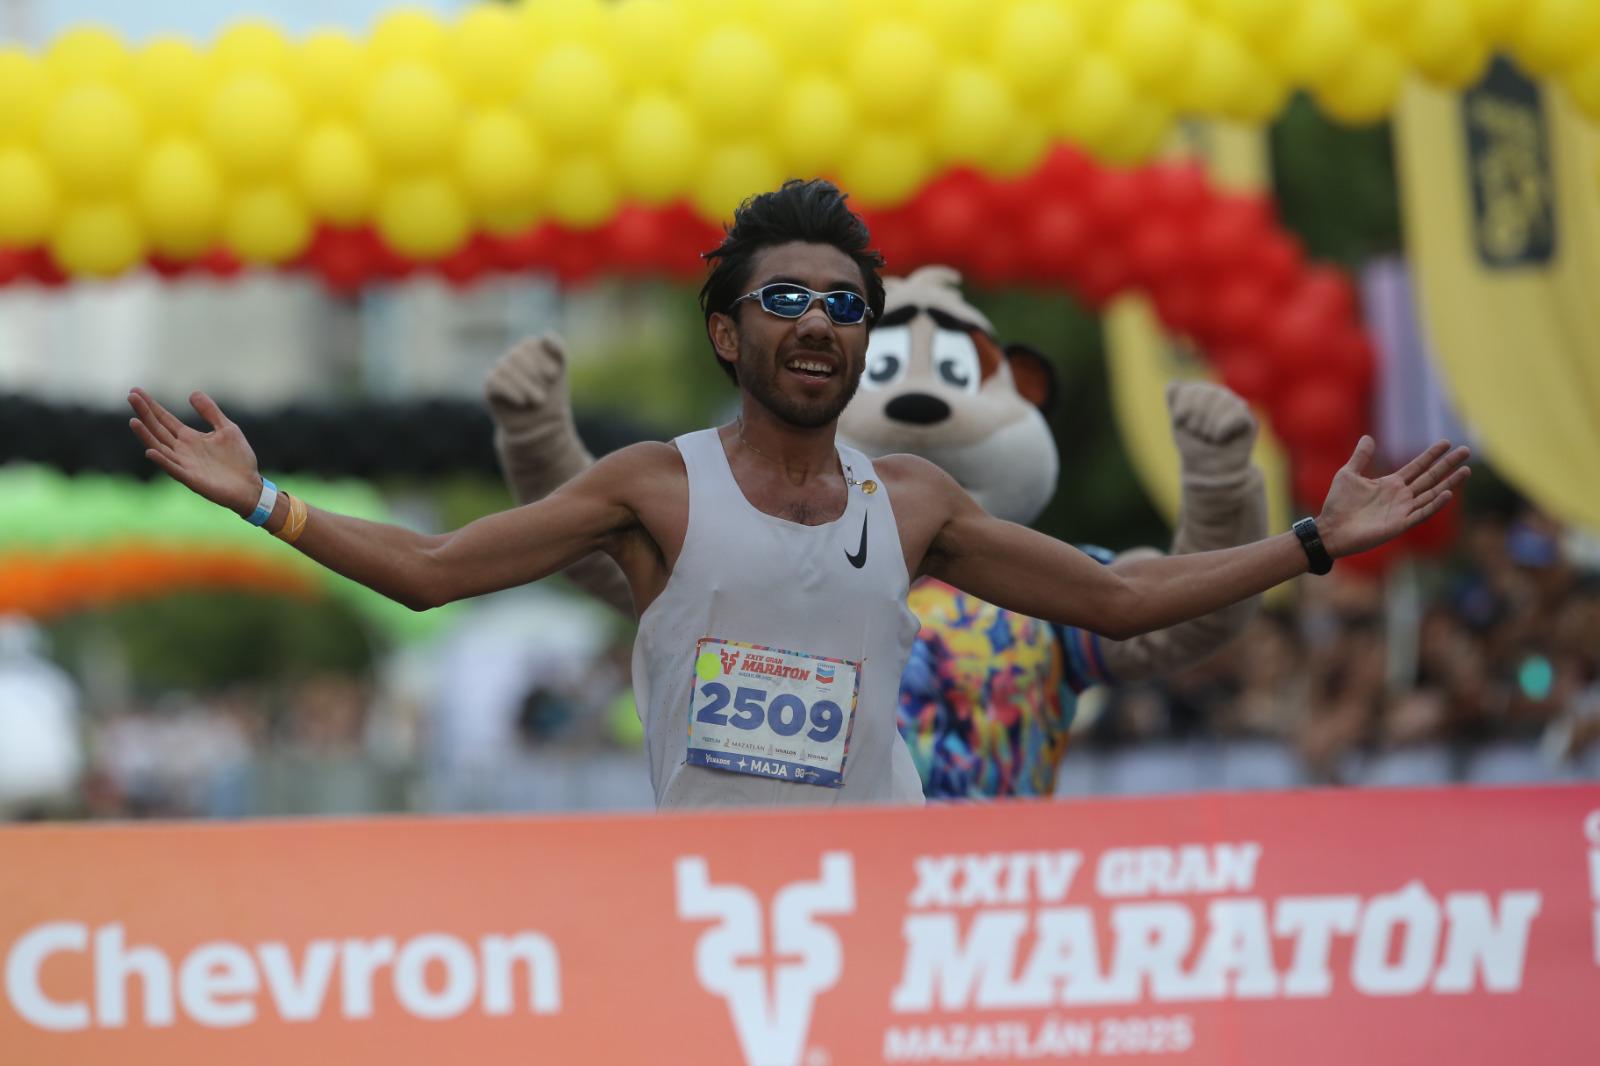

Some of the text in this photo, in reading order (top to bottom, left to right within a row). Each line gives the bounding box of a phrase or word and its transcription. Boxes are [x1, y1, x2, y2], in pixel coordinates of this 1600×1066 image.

[697, 682, 844, 743] 2509
[751, 760, 788, 777] MAJA
[907, 841, 1263, 907] XXIV GRAN
[4, 920, 562, 1032] Chevron
[890, 879, 1542, 1013] MARATÓN
[883, 1013, 1195, 1063] MAZATLÁN 2025
